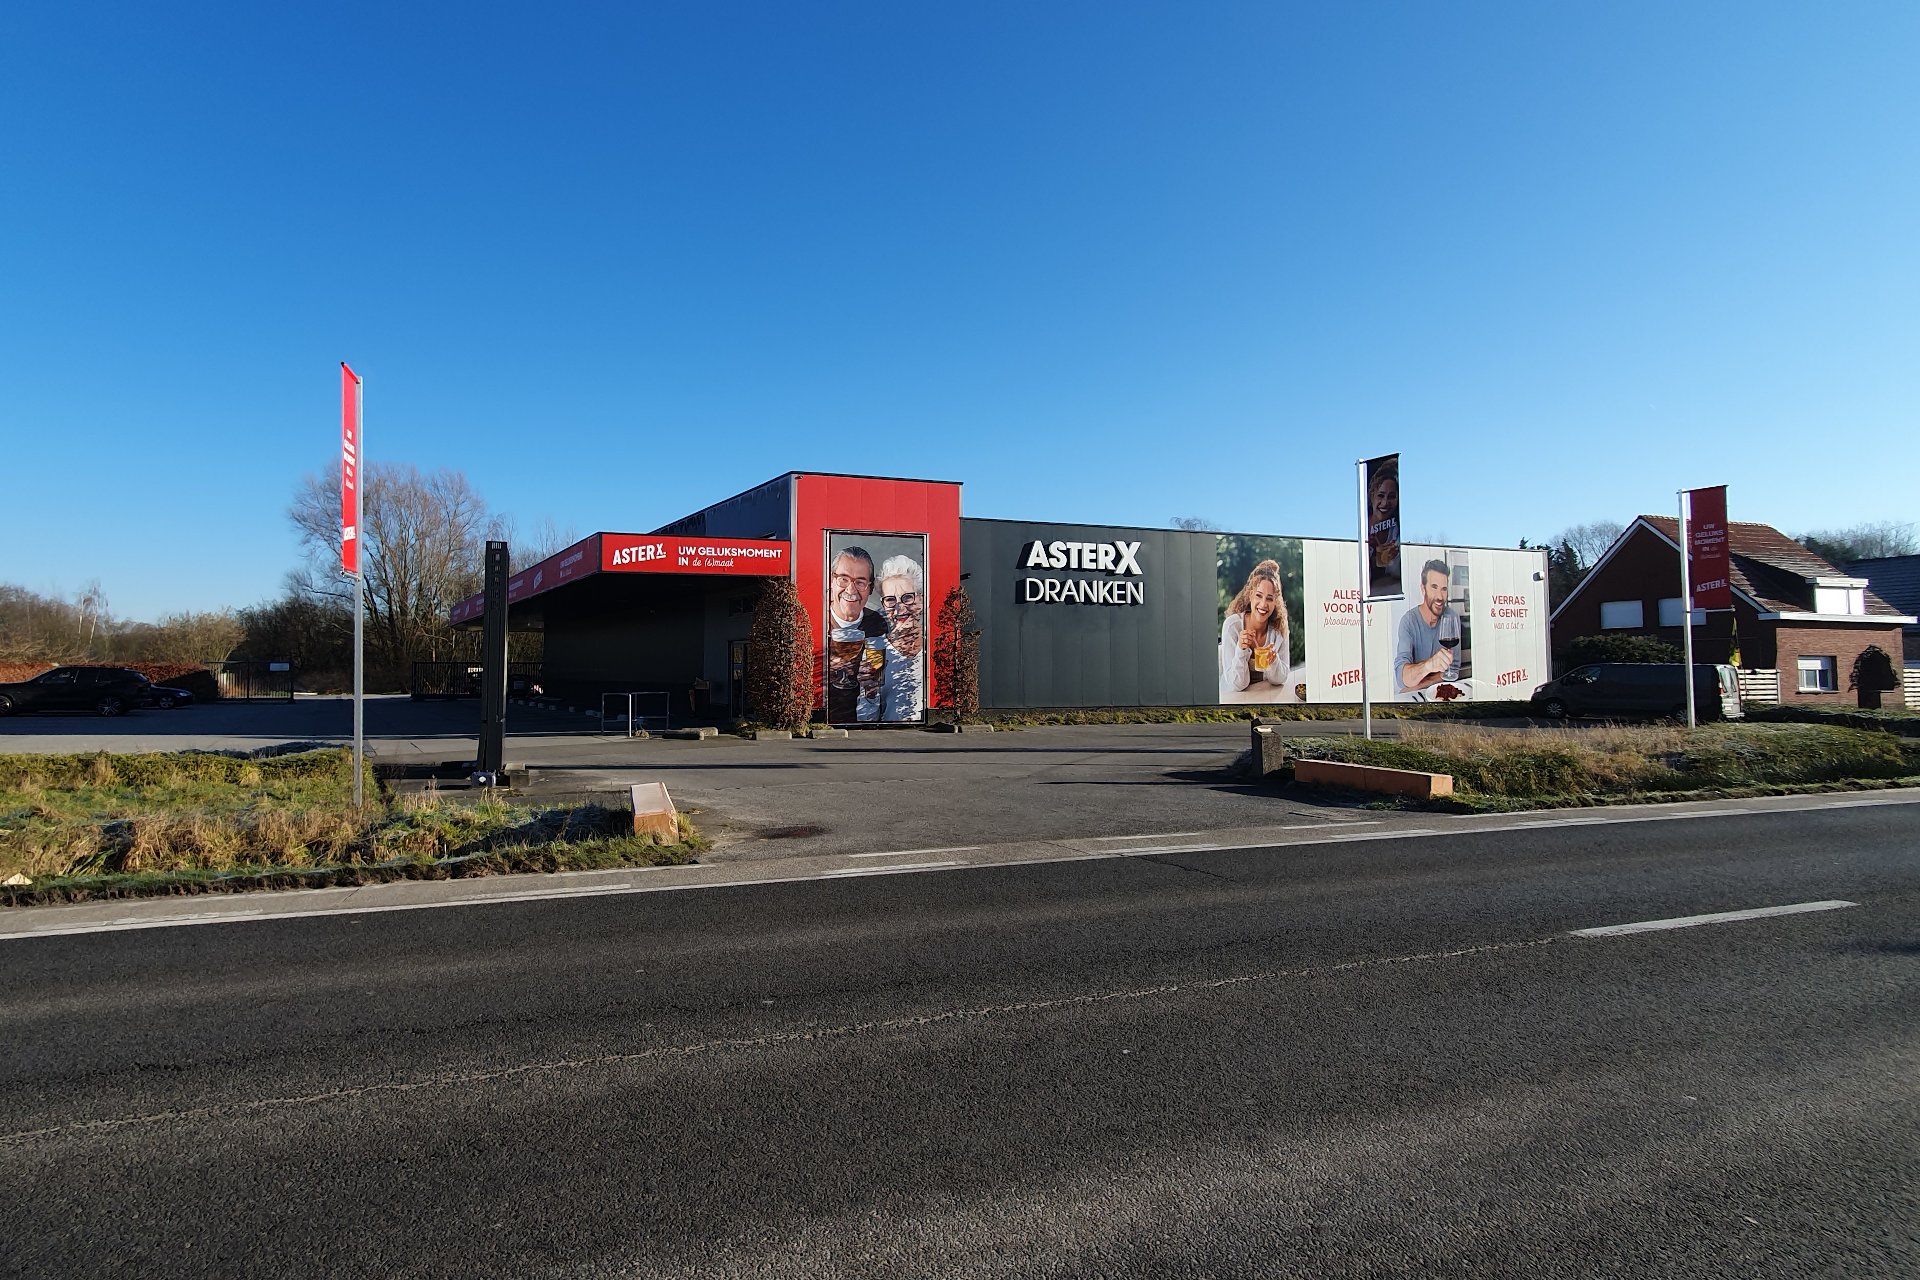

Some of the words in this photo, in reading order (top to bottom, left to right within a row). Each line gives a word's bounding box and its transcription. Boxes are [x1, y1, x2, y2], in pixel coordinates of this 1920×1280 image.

[678, 546, 697, 556] UW
[698, 546, 783, 559] GELUKSMOMENT
[1026, 540, 1144, 575] ASTERX
[678, 557, 689, 566] IN
[692, 557, 702, 567] de
[1024, 577, 1145, 605] DRANKEN
[1492, 595, 1526, 606] VERRAS
[1323, 602, 1354, 614] VOOR
[1490, 608, 1497, 618] &
[1498, 608, 1529, 618] GENIET
